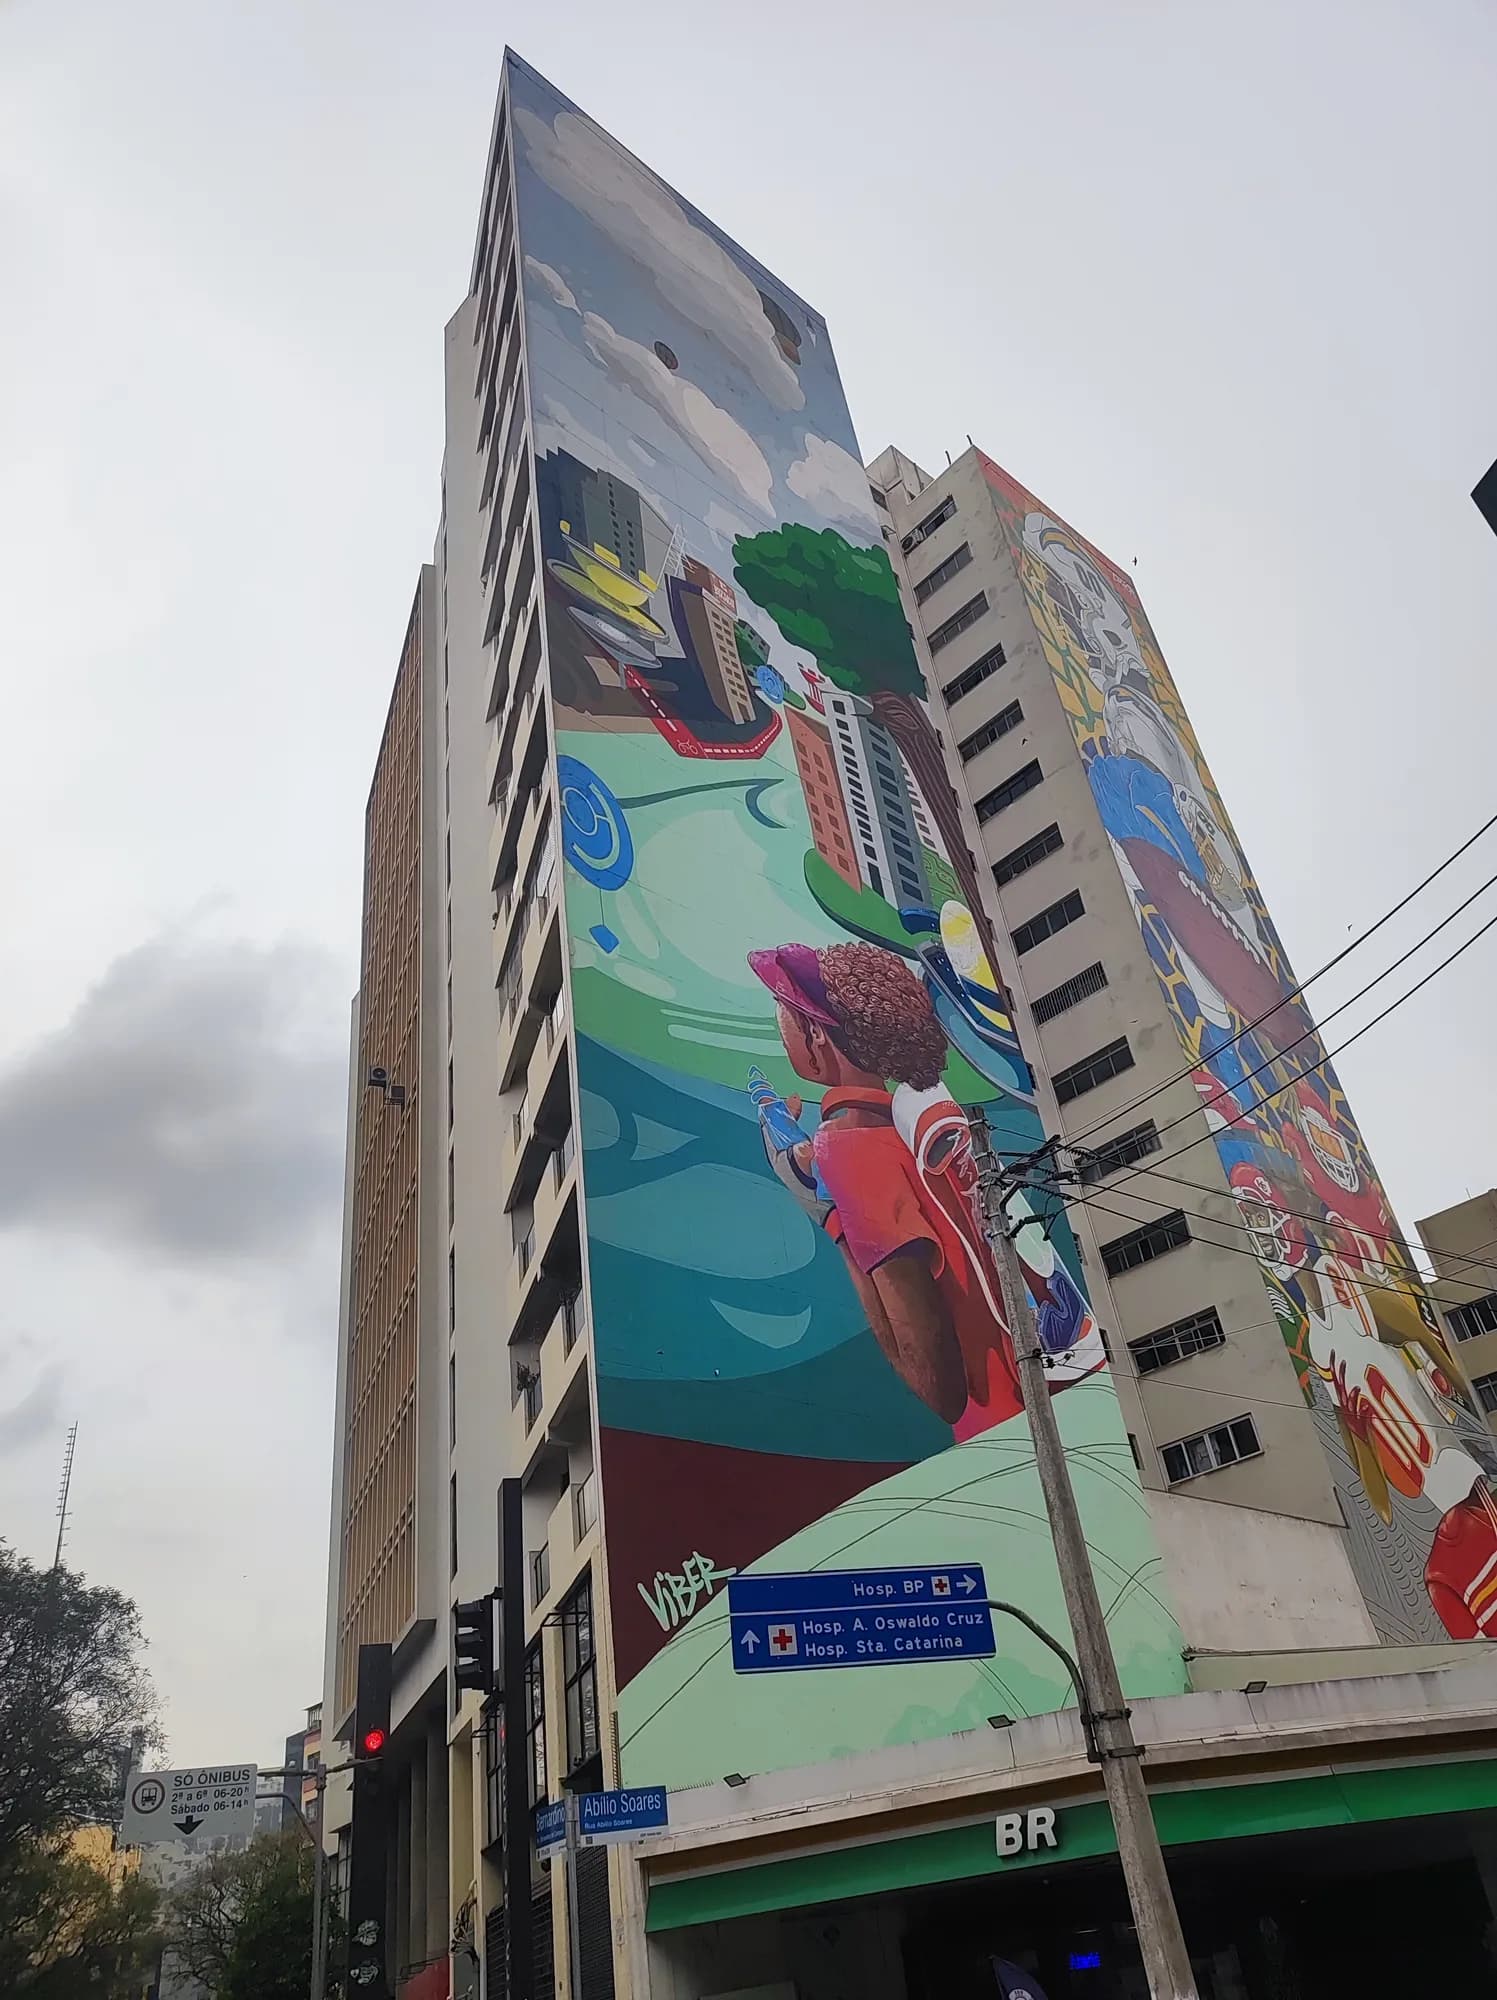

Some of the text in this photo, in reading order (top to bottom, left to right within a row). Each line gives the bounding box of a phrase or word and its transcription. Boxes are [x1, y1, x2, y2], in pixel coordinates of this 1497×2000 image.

[853, 1580, 924, 1598] Hosp. BP
[803, 1612, 984, 1636] Hosp. A. Oswaldo Cruz
[805, 1634, 963, 1659] Hosp. Sta. Catarina
[174, 1769, 250, 1787] SÓ ÔNIBUS
[187, 1793, 193, 1801] a
[584, 1793, 661, 1817] Abílio Soares
[170, 1803, 210, 1815] Sábado
[996, 1807, 1058, 1857] BR
